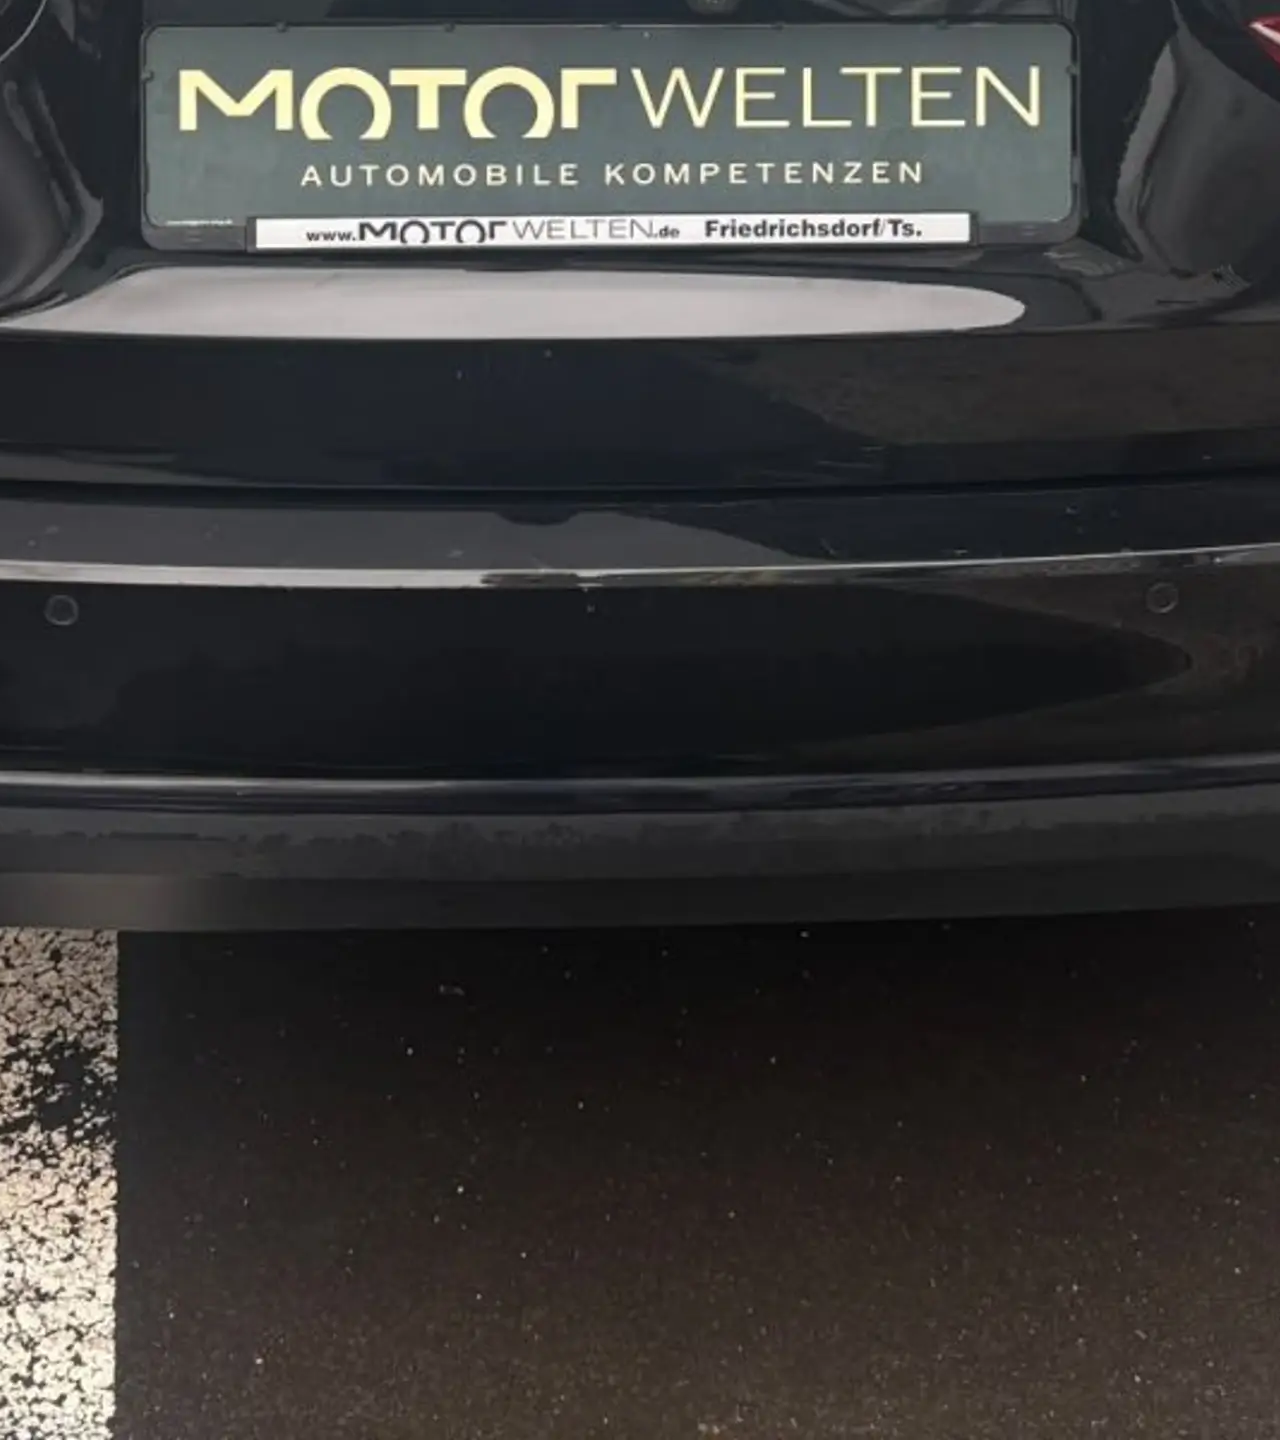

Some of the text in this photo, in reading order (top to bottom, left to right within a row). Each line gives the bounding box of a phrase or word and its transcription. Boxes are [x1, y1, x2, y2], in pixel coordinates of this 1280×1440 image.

[300, 162, 923, 187] AUTOMOBILE KOMPETENZEN
[705, 218, 923, 238] Friedrichsdorf/Ts.
